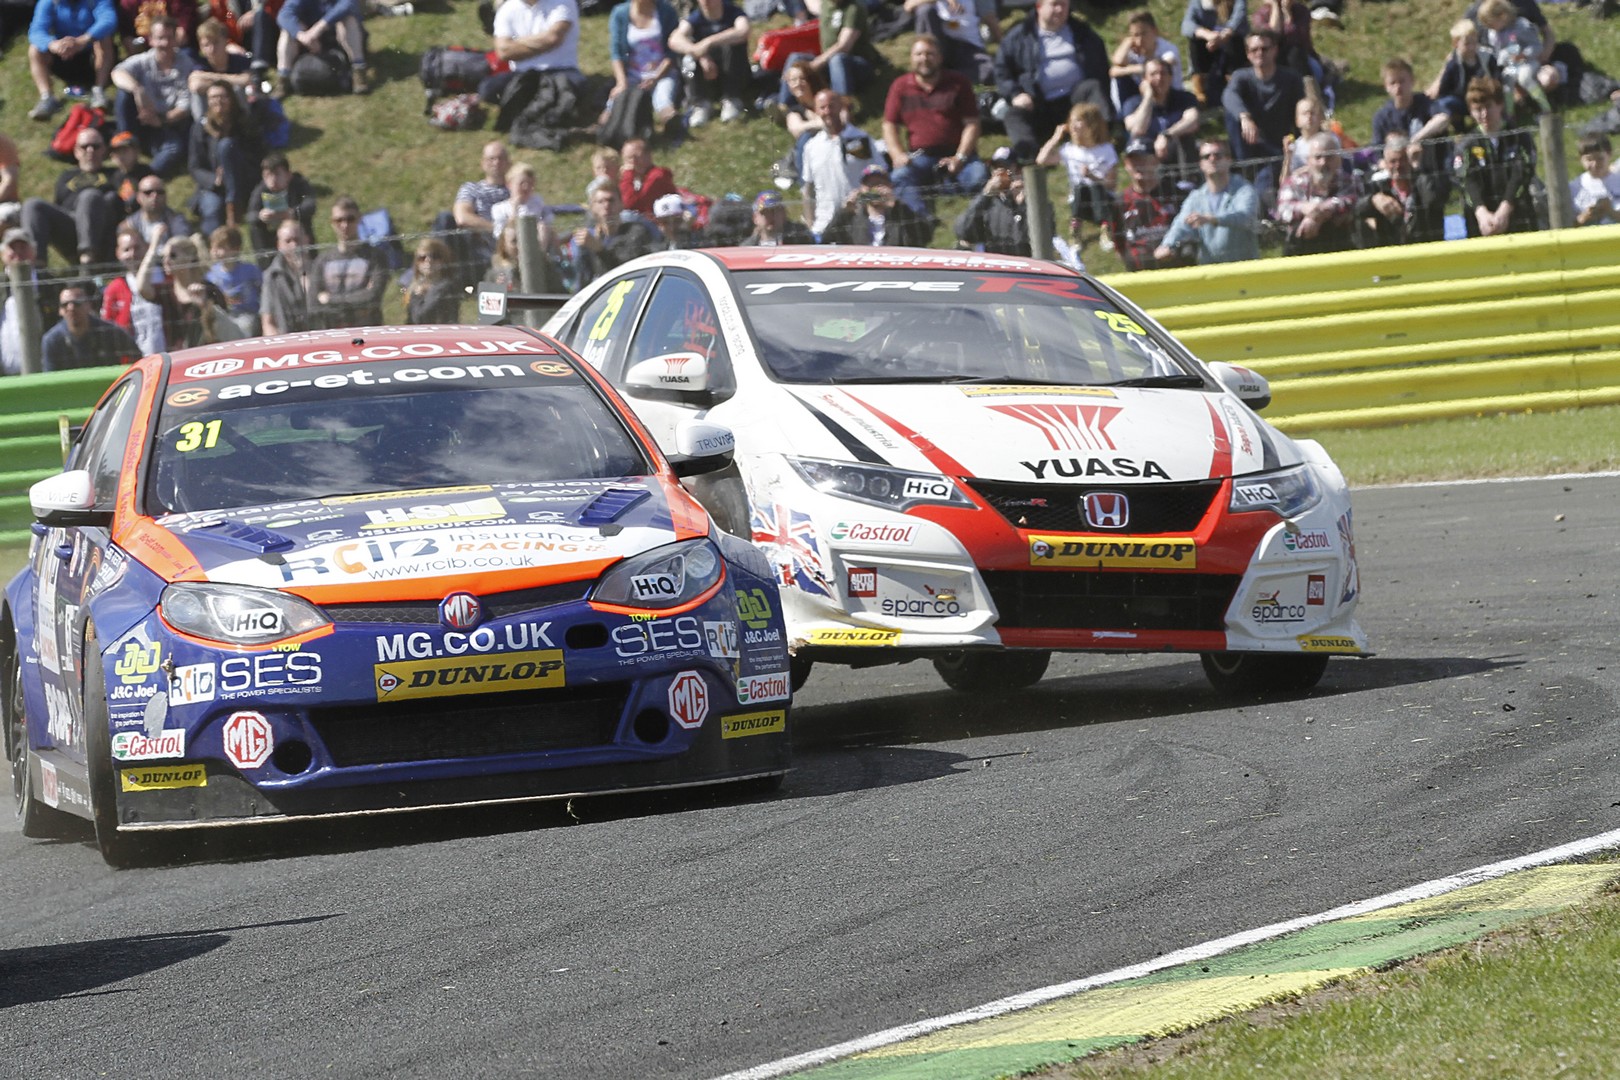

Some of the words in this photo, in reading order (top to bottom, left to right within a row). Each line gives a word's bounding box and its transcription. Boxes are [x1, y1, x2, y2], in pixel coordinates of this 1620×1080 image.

[745, 281, 965, 295] TYPE
[973, 276, 1105, 302] R
[1094, 310, 1147, 336] 25
[253, 340, 544, 371] MG.CO.UK
[217, 363, 526, 400] ac-et.com
[657, 376, 690, 384] YUASA
[175, 419, 223, 452] 31
[696, 432, 734, 450] TRUVAPE
[1018, 458, 1173, 481] YUASA
[906, 481, 948, 496] HiQ
[1240, 486, 1278, 502] HiQ
[365, 497, 507, 525] HSL
[358, 518, 517, 538] HSLGROUP.COM
[449, 531, 608, 543] Insurance
[849, 523, 914, 542] Castrol
[455, 541, 579, 552] RACING
[1295, 531, 1331, 549] Castrol
[1059, 541, 1194, 560] DUNLOP
[368, 555, 535, 580] www.rcib.co.uk
[634, 577, 677, 597] HiQ
[850, 573, 875, 583] AUTO
[444, 595, 479, 627] MG
[882, 598, 960, 618] sparco
[1252, 604, 1306, 623] sparco
[236, 611, 279, 632] HiQ
[629, 614, 651, 622] TOW
[376, 621, 556, 662] MG.CO.UK
[611, 616, 702, 657] SES
[744, 631, 762, 644] J&C
[763, 629, 781, 642] Joel
[818, 632, 898, 641] DUNLOP
[1310, 635, 1356, 648] DUNLOP
[277, 643, 301, 652] TOW
[636, 654, 665, 664] POWER
[666, 649, 706, 660] SPECIALISTS
[221, 651, 322, 692] SES
[408, 660, 564, 689] DUNLOP
[110, 685, 133, 700] J&C
[134, 683, 157, 698] Joel
[220, 692, 236, 701] THE
[236, 689, 266, 699] POWER
[267, 686, 322, 696] SPECIALISTS
[750, 679, 787, 699] Castrol
[674, 680, 705, 721] MG
[731, 715, 781, 732] DUNLOP
[130, 734, 181, 756] Castrol
[229, 718, 266, 763] MG
[141, 770, 202, 784] DUNLOP
